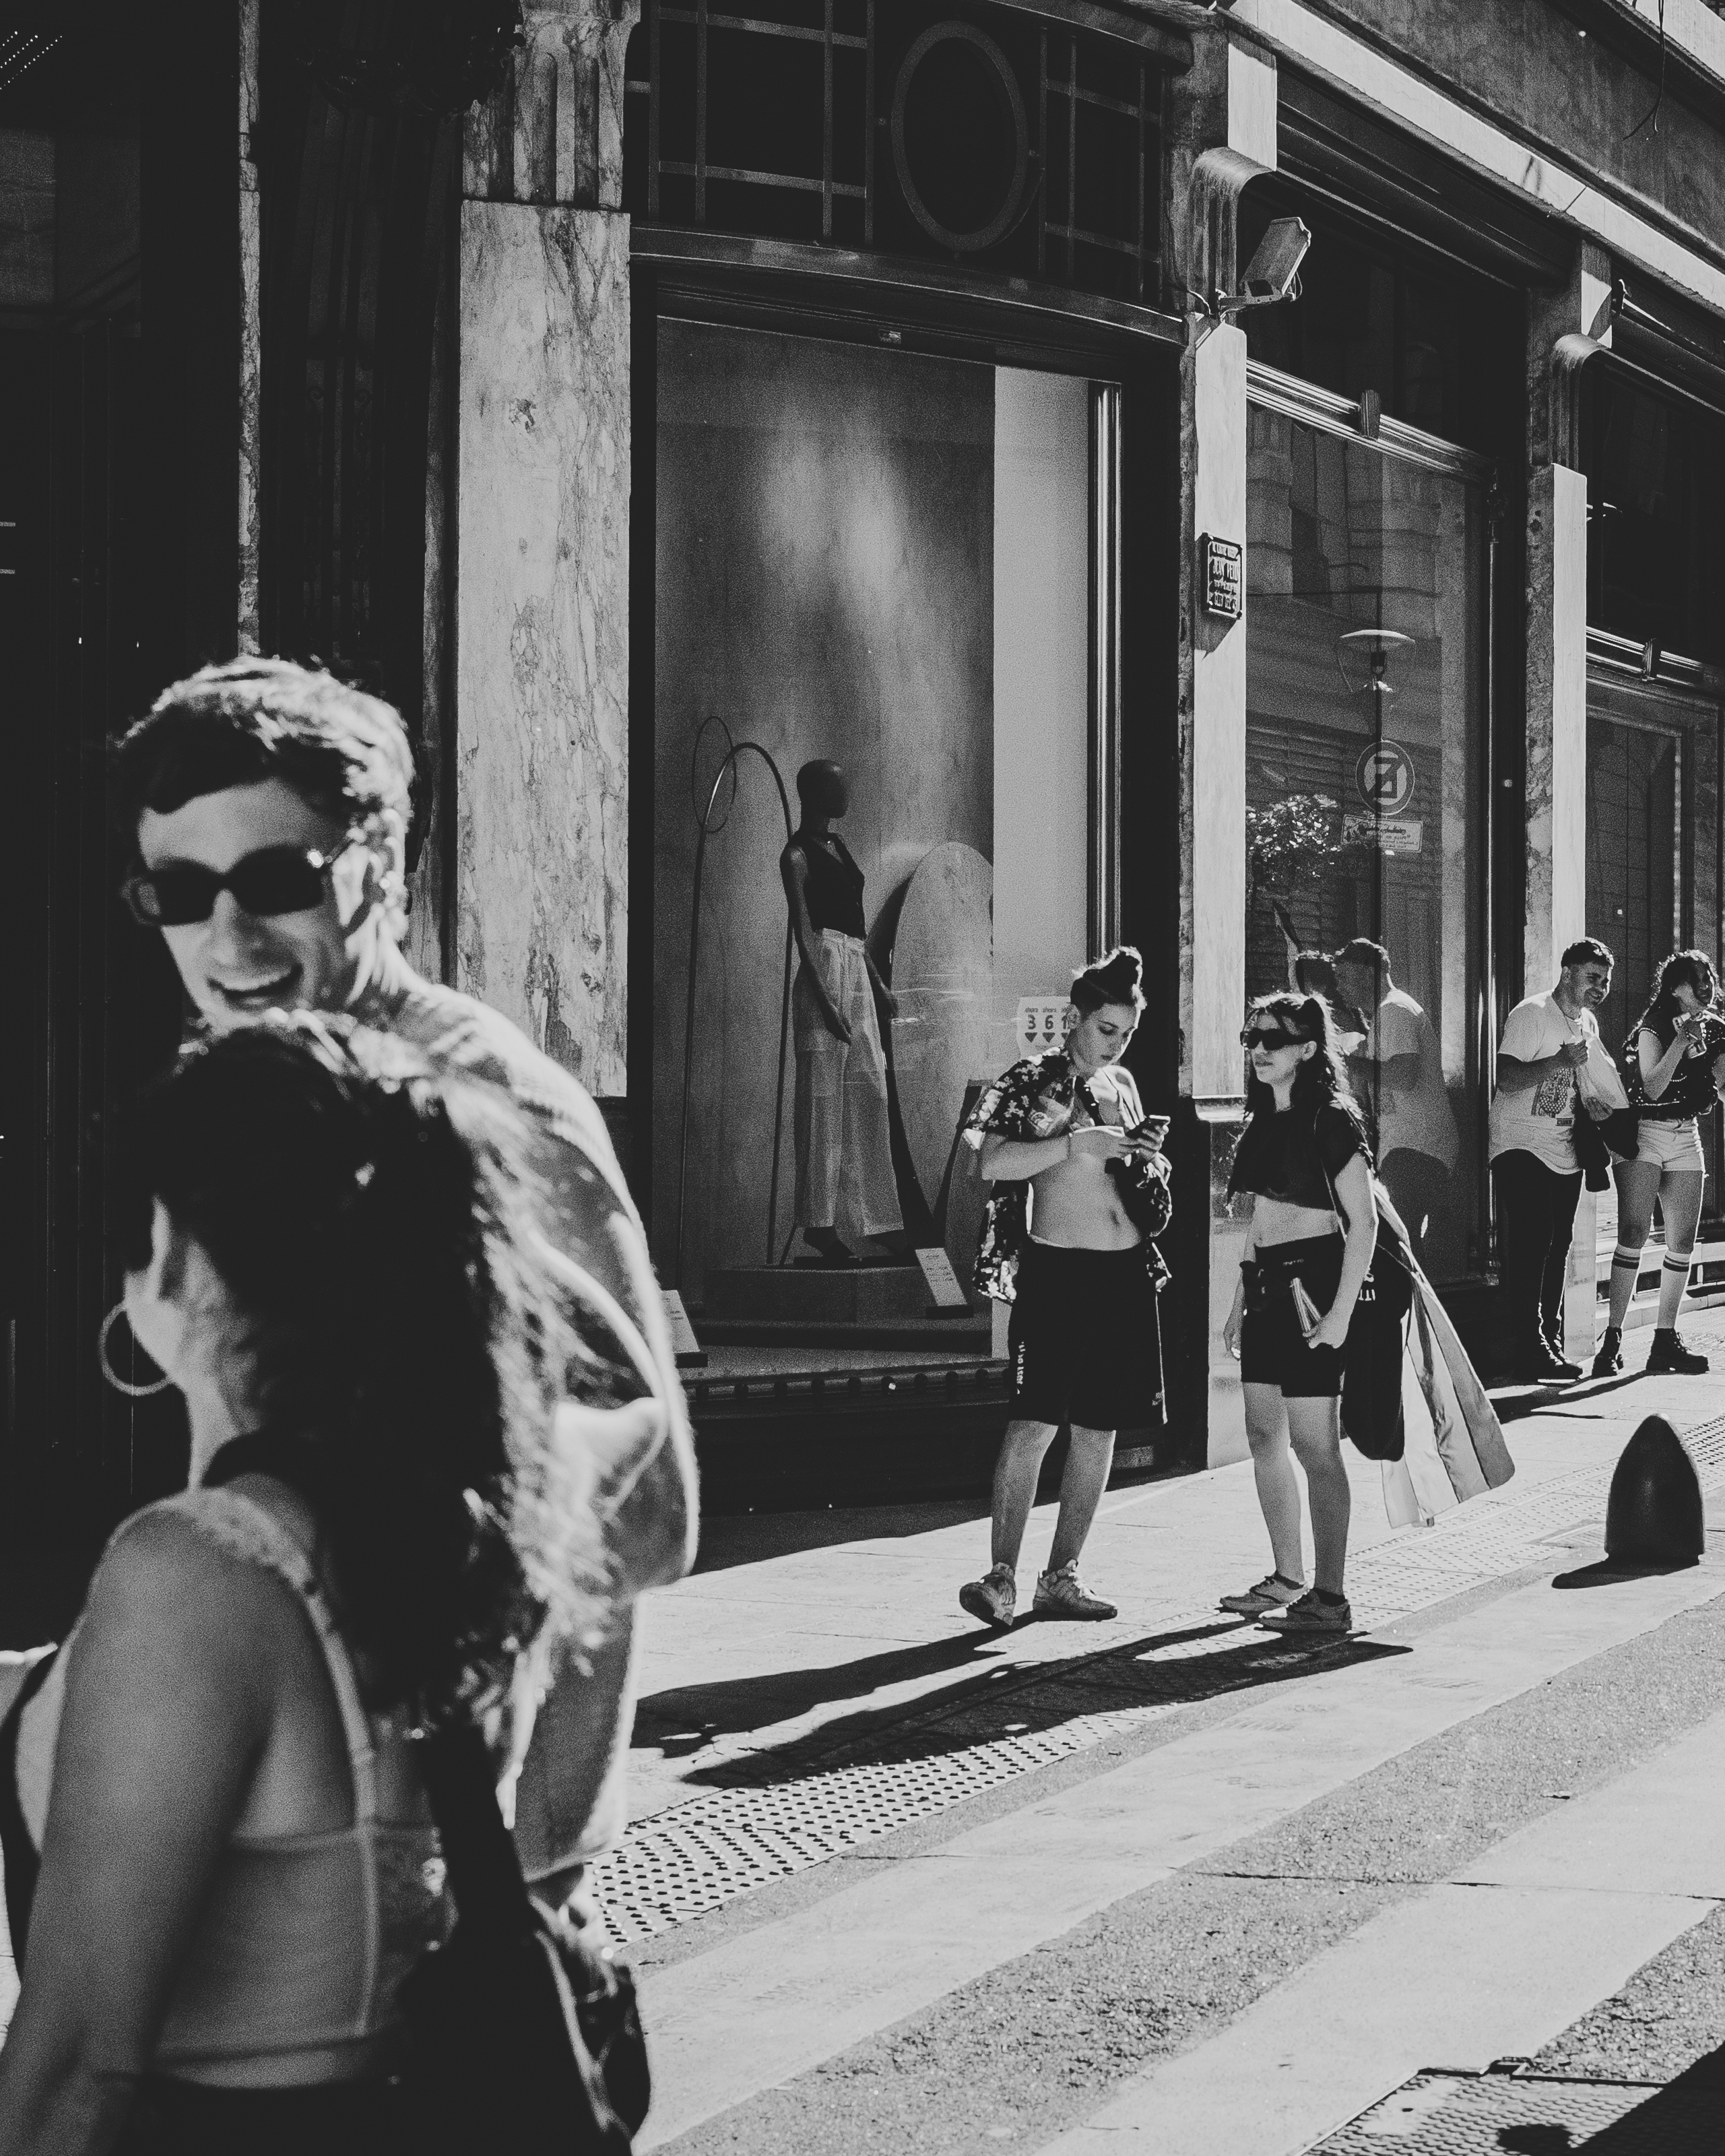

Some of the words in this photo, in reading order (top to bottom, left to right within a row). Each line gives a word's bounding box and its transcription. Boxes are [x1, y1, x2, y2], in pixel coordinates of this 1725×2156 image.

[1028, 1014, 1037, 1029] 3
[1045, 1015, 1053, 1029] 6
[1016, 1366, 1024, 1385] JUST
